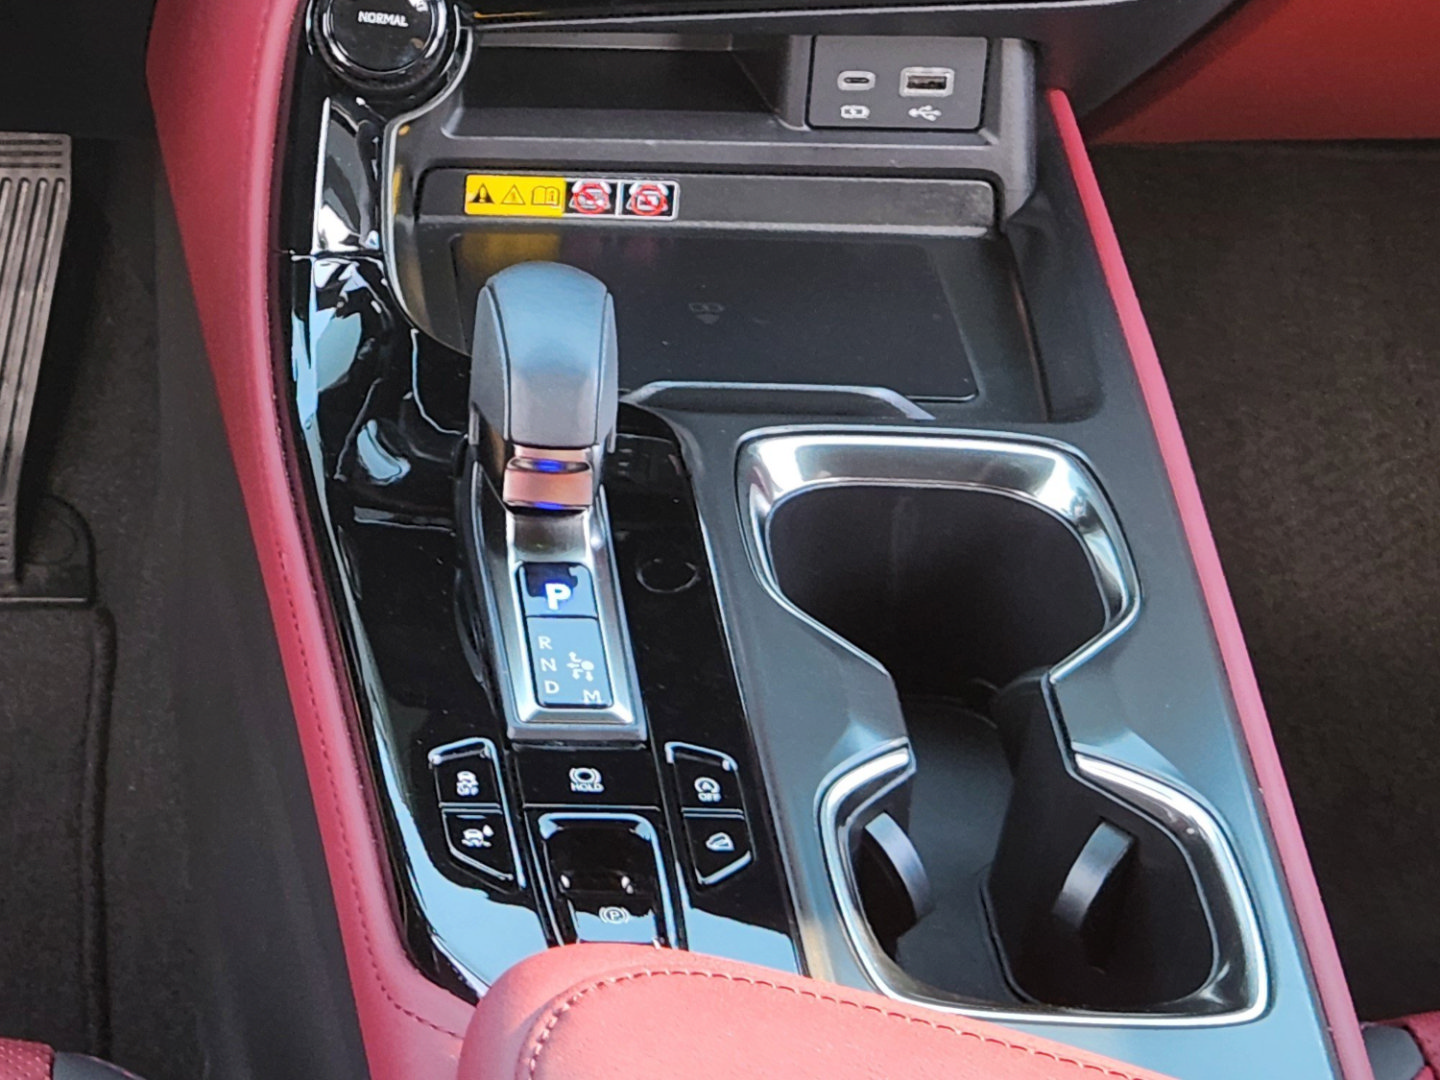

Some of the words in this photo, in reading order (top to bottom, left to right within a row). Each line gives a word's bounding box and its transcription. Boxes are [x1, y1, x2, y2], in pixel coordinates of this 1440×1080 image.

[357, 10, 409, 28] NORMAL
[544, 582, 572, 611] P
[537, 635, 553, 650] R
[539, 657, 558, 673] N
[544, 679, 560, 695] D
[582, 689, 602, 705] M
[570, 782, 604, 793] HOLD
